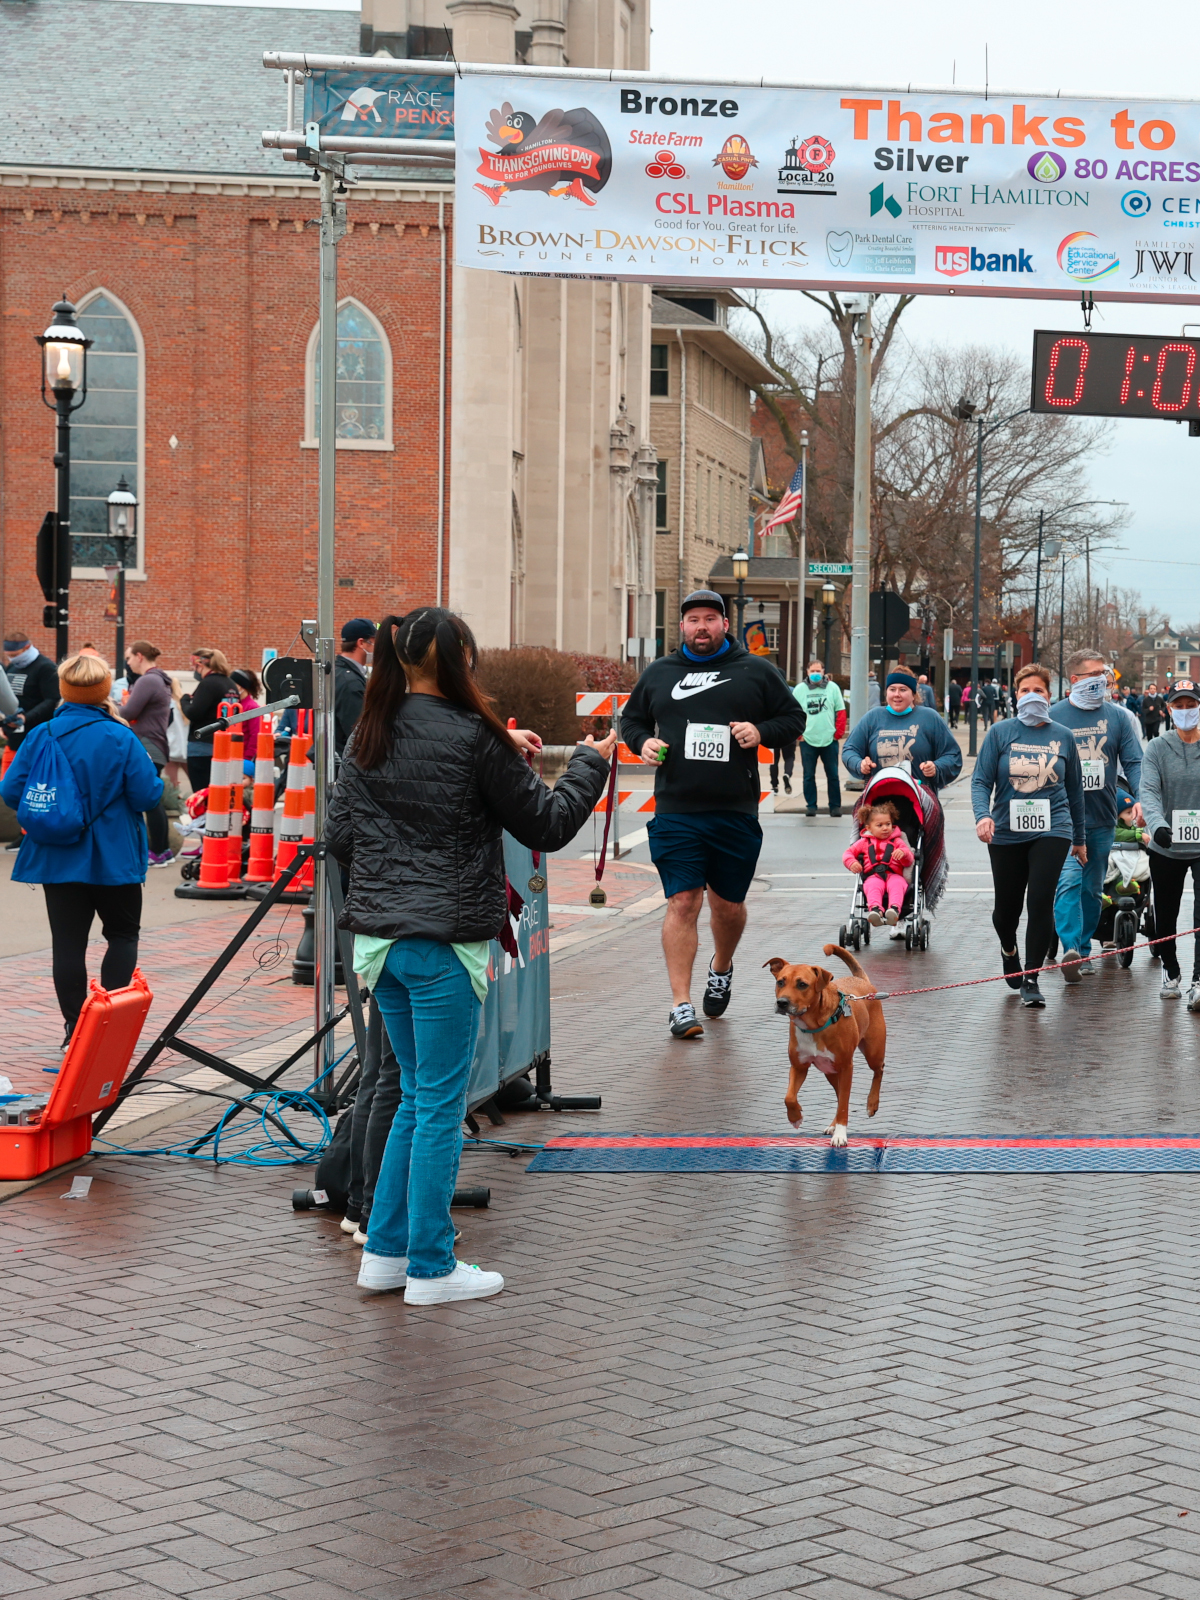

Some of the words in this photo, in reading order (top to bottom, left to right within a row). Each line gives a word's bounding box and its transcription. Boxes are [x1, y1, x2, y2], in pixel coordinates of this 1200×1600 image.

[388, 90, 442, 107] RACE
[620, 88, 739, 118] Bronze
[840, 98, 1087, 148] Thanks
[1110, 108, 1176, 151] to
[524, 138, 553, 152] HAMILTON
[487, 147, 569, 173] THANKSGIVING
[571, 149, 592, 169] DAY
[873, 147, 969, 173] Silver
[504, 172, 514, 180] 5K
[515, 169, 529, 179] FOR
[530, 161, 572, 176] YOUNGLIVES
[778, 170, 814, 182] Local
[818, 172, 834, 183] 20
[1074, 158, 1108, 179] 80
[1115, 160, 1200, 182] ACRES
[716, 181, 754, 191] Hamilton!
[906, 182, 962, 204] FORT
[970, 184, 1090, 208] HAMILTON
[655, 192, 701, 215] CSL
[707, 194, 796, 219] Plasma
[908, 205, 965, 217] HOSPITAL
[654, 219, 683, 230] Good
[686, 220, 700, 230] for
[703, 221, 725, 231] You.
[728, 222, 757, 232] Great
[760, 222, 775, 233] for
[777, 223, 799, 234] Life.
[913, 224, 948, 232] KETTERING
[855, 234, 870, 243] Park
[872, 234, 895, 243] Dental
[896, 235, 912, 243] Care
[1135, 240, 1195, 249] HAMILTON
[519, 250, 656, 263] FUNERAL
[690, 256, 769, 267] HOME
[1067, 258, 1098, 267] Service
[1068, 250, 1116, 260] Educational
[1067, 265, 1094, 274] Center
[813, 564, 843, 573] SECOND
[680, 671, 721, 687] NIKE
[692, 741, 724, 759] 1929
[1016, 815, 1045, 830] 1805
